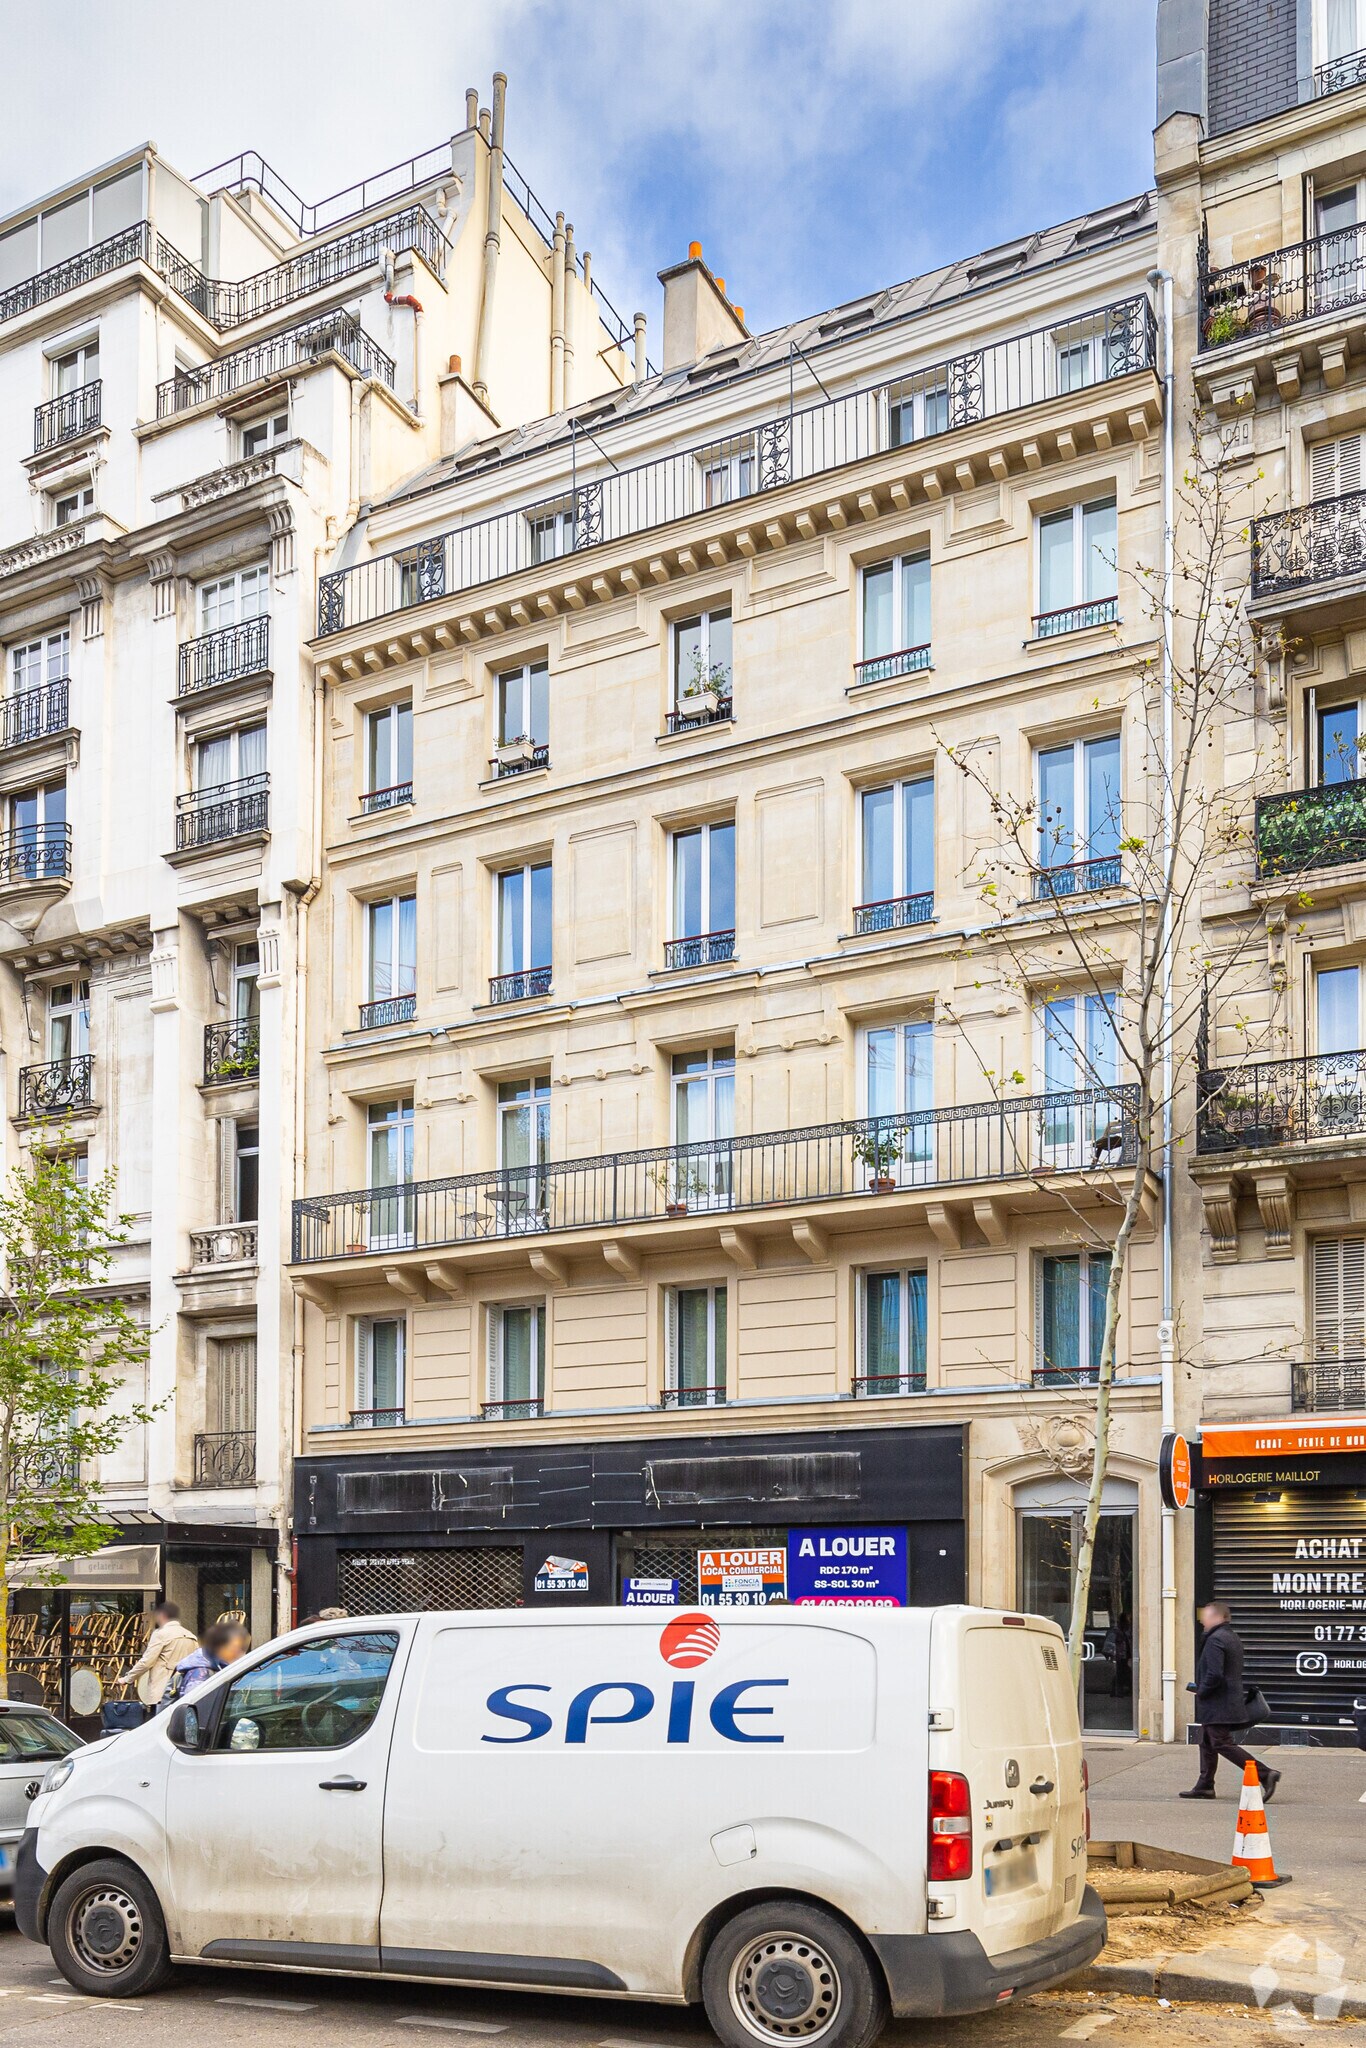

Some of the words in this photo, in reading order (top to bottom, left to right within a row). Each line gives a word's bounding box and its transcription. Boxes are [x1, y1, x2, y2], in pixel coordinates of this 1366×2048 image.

[1255, 1438, 1282, 1449] ACHAT
[1298, 1437, 1324, 1447] VENTE
[1330, 1436, 1340, 1446] DE
[1208, 1472, 1272, 1484] HORLOGERIE
[1275, 1471, 1320, 1482] MAILLOT
[798, 1538, 816, 1557] A
[820, 1536, 896, 1556] LOUER
[1295, 1538, 1363, 1559] ACHAT
[702, 1553, 715, 1567] A
[720, 1551, 782, 1566] LOUER
[701, 1566, 728, 1576] LOCAL
[729, 1565, 783, 1575] COMMERCIAL
[820, 1566, 840, 1574] RDC
[841, 1566, 859, 1574] 170
[537, 1580, 545, 1589] 01
[547, 1580, 556, 1589] 55
[557, 1580, 566, 1588] 30
[567, 1579, 576, 1588] 10
[577, 1579, 586, 1588] 40
[814, 1580, 850, 1588] SS-SOL
[851, 1580, 865, 1588] 30
[626, 1592, 635, 1603] A
[637, 1592, 675, 1604] LOUER
[702, 1593, 715, 1606] 01
[719, 1592, 733, 1605] 55
[735, 1592, 749, 1605] 30
[752, 1592, 766, 1605] 10
[1314, 1626, 1332, 1641] 01
[1335, 1626, 1355, 1641] 77
[480, 1679, 789, 1744] SPIE
[983, 1799, 1014, 1810] Jumpy
